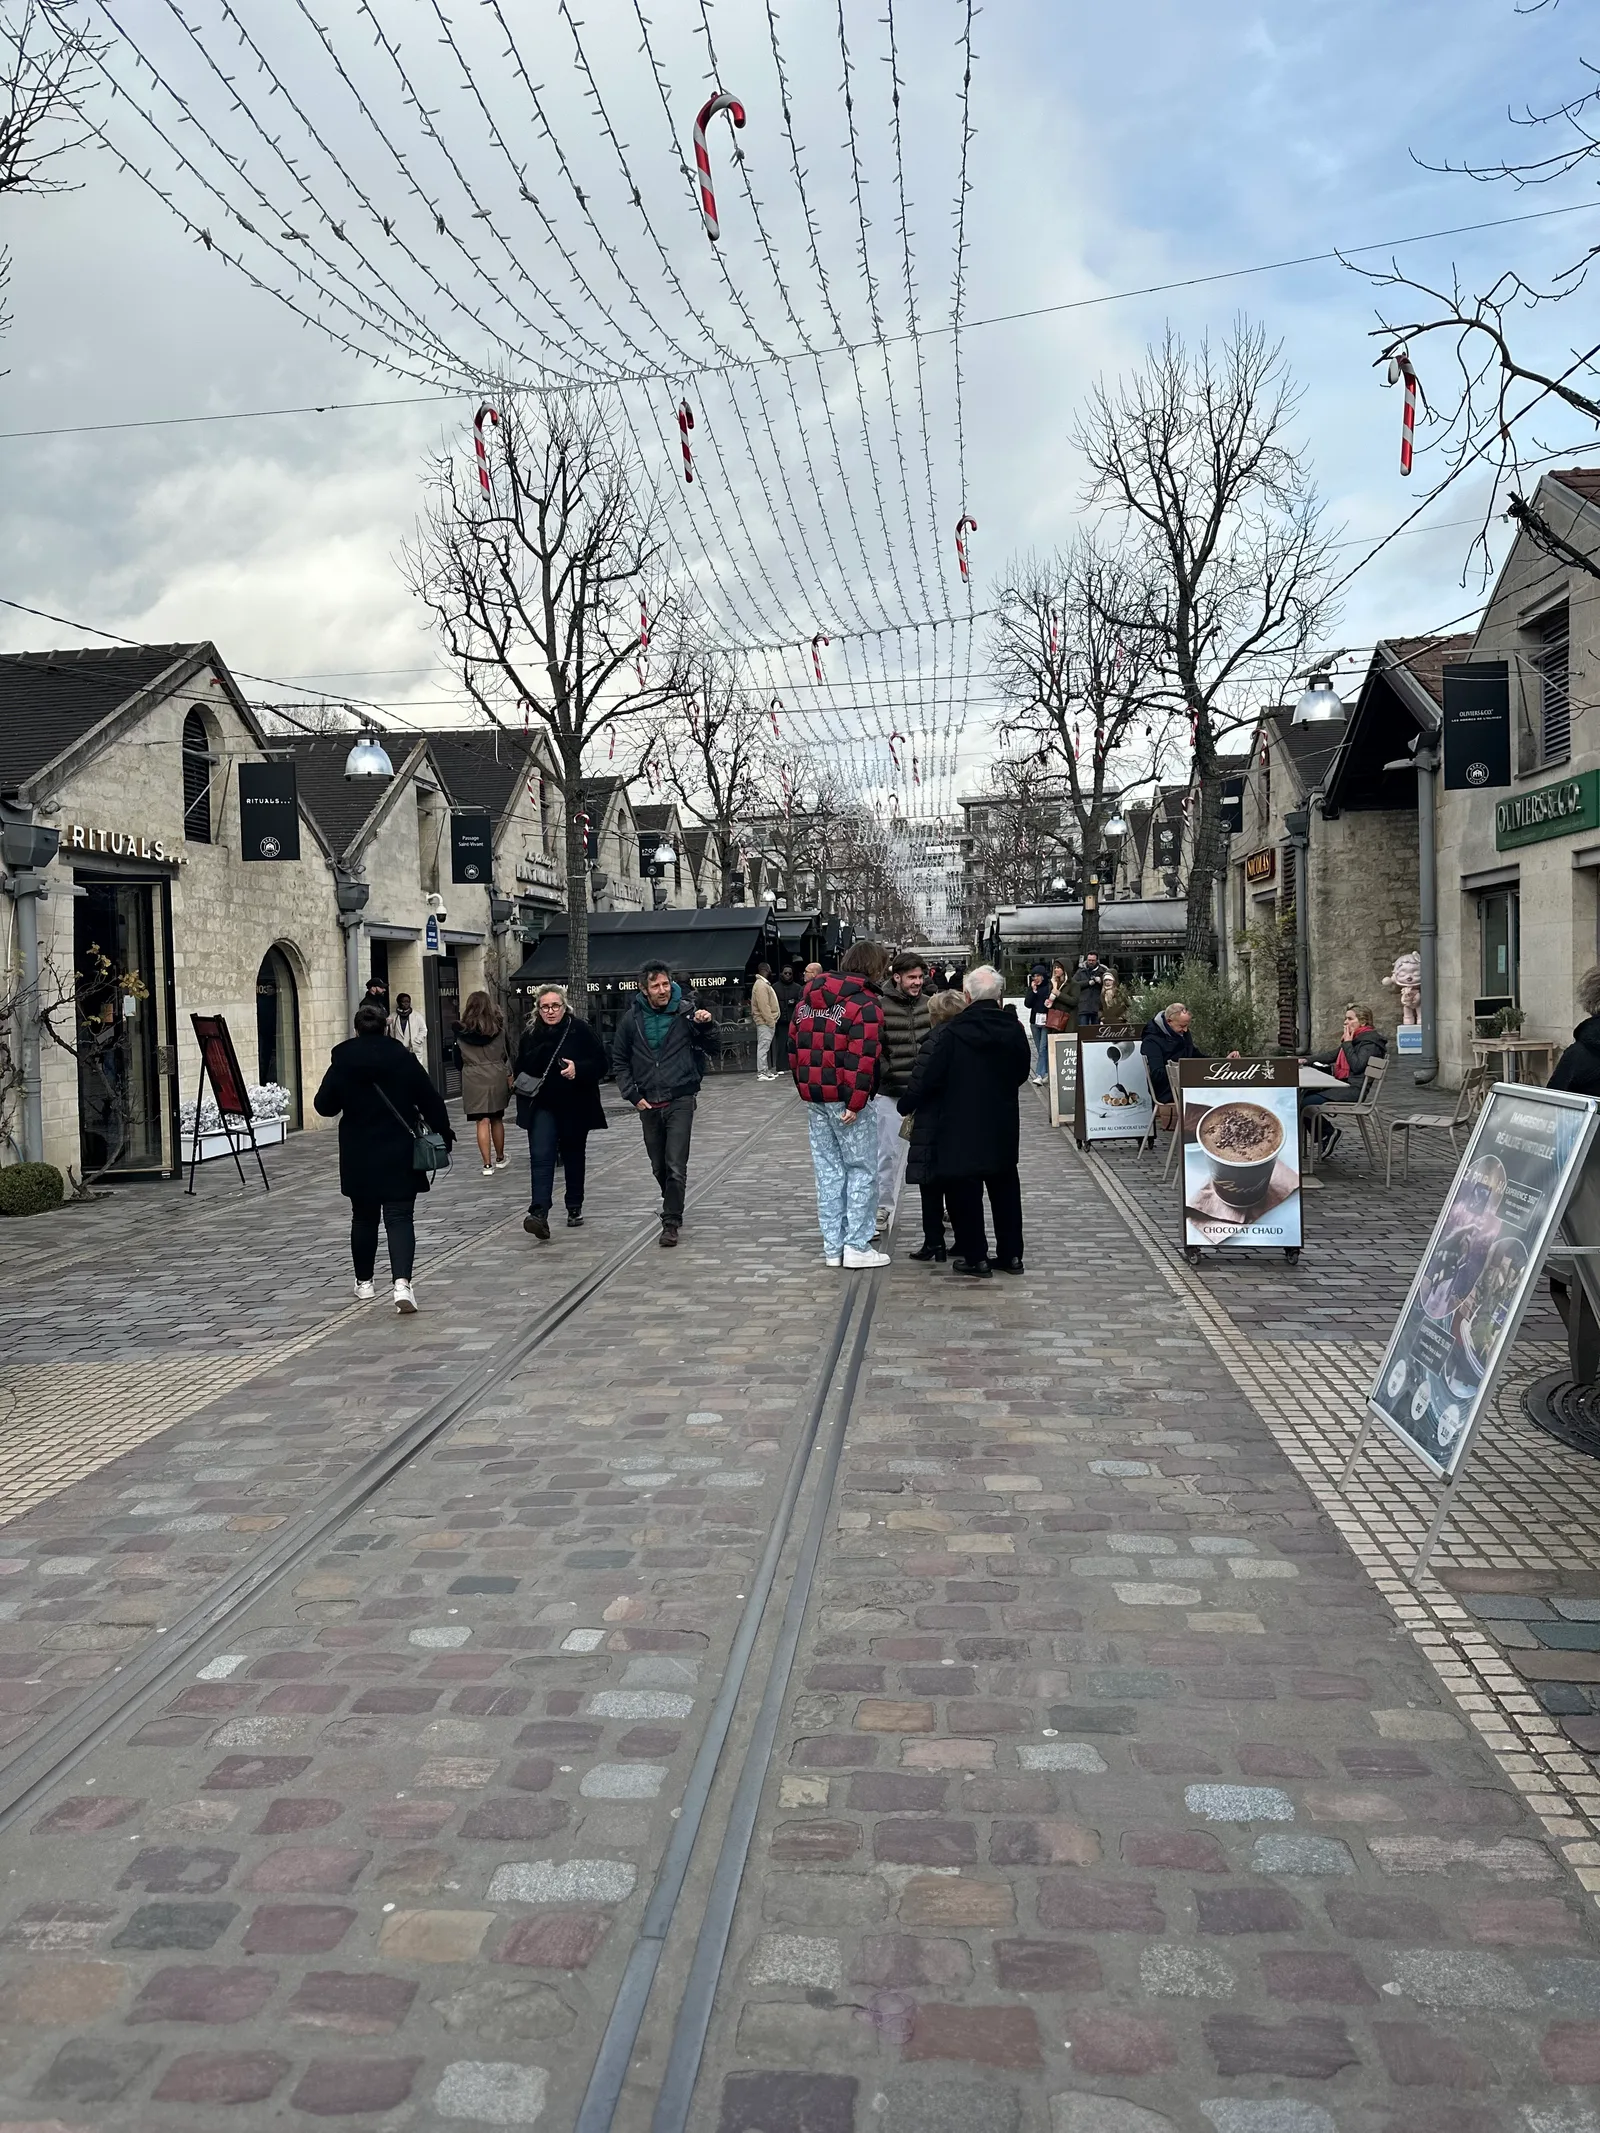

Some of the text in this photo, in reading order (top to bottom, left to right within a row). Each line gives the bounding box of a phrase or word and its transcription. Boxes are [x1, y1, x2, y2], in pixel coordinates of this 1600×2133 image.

[1247, 853, 1269, 877] NICOLAS
[707, 976, 727, 987] SHOP
[1096, 1026, 1128, 1039] Lindt
[1203, 1062, 1261, 1080] Lindt
[1203, 1226, 1284, 1235] CHOCOLAT CHAUD
